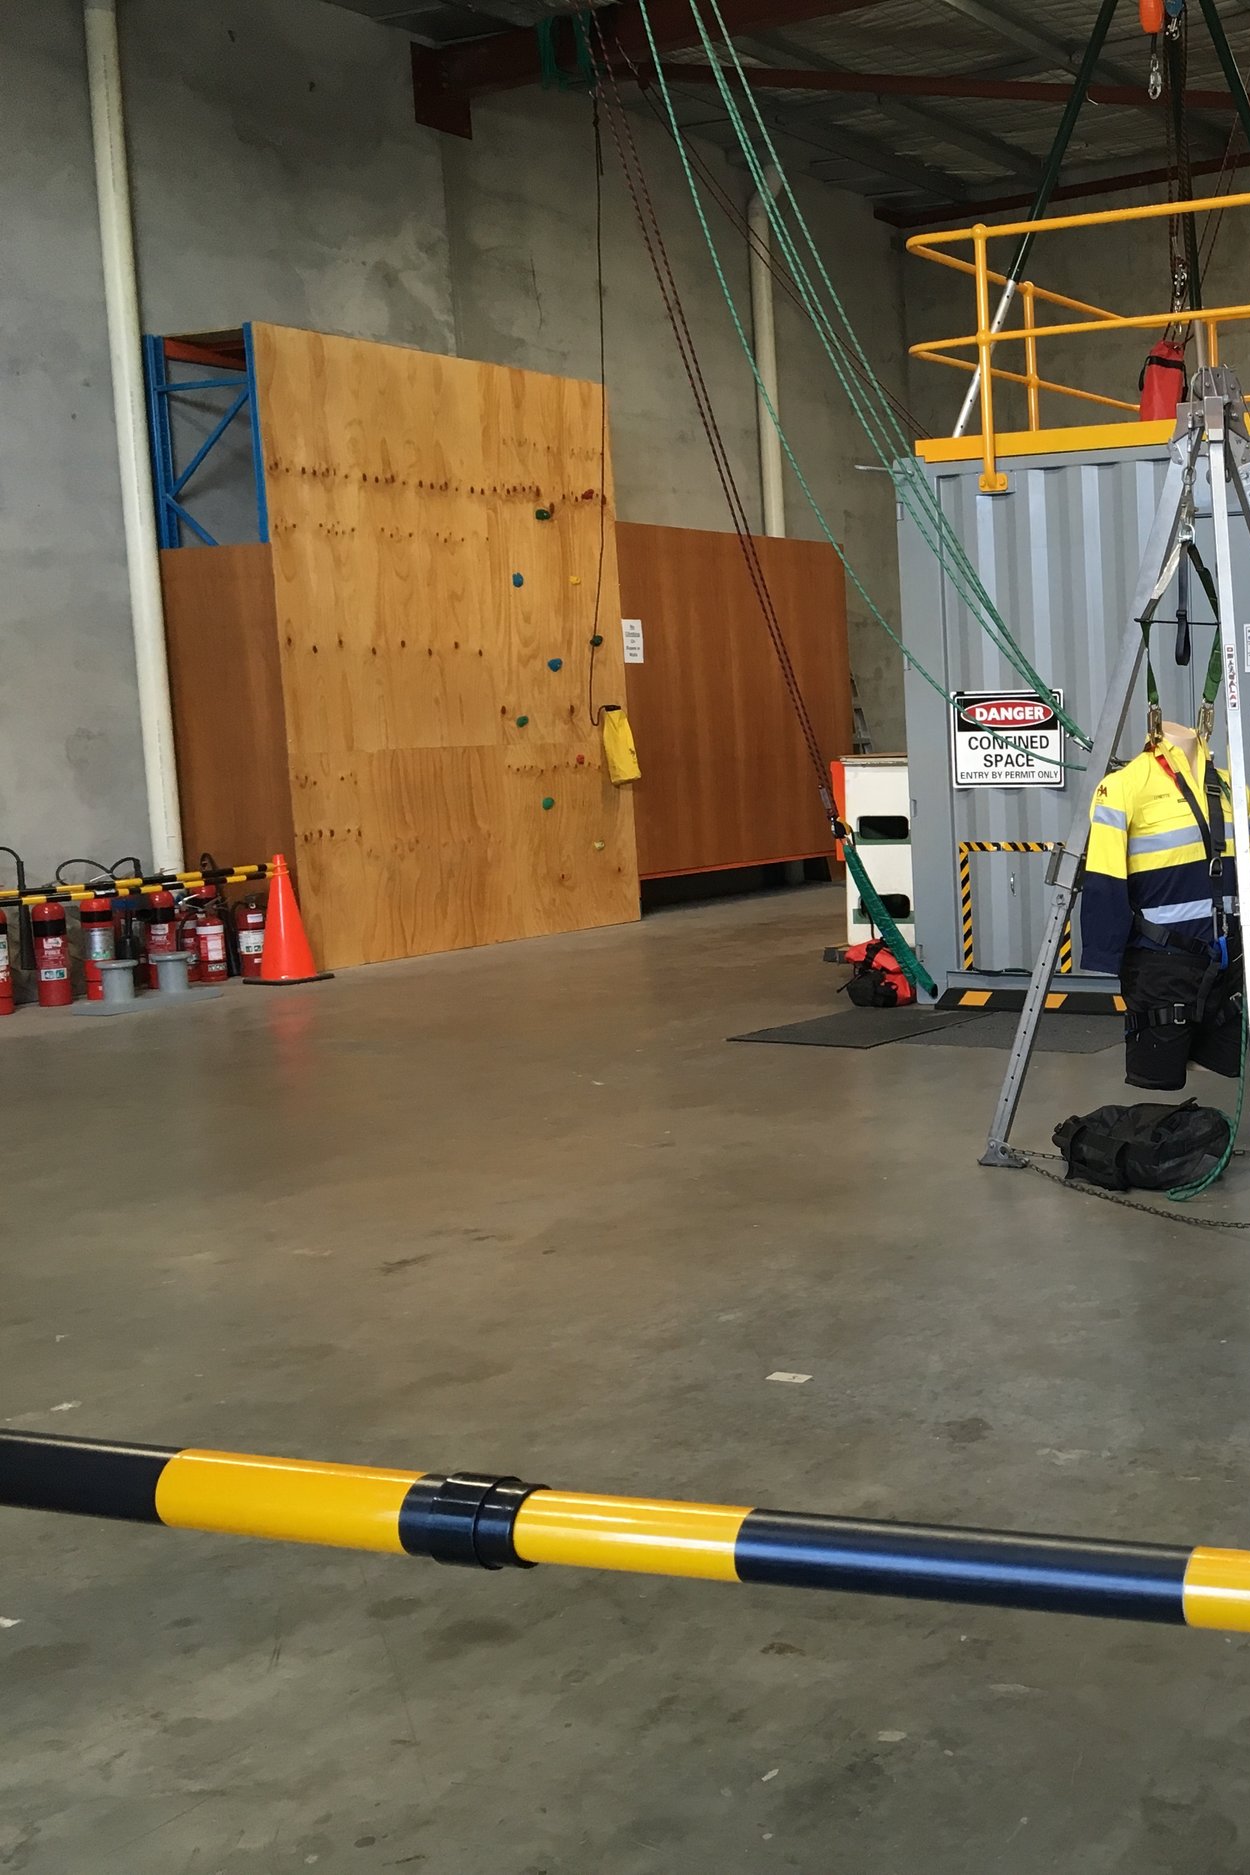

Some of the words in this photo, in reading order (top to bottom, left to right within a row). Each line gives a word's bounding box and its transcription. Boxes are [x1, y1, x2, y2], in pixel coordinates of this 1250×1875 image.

[975, 706, 1045, 721] DANGER
[968, 735, 1050, 750] CONFINED
[983, 754, 1035, 768] SPACE
[960, 771, 989, 779] ENTRY
[991, 771, 1003, 779] BY
[1005, 770, 1035, 779] PERMIT
[1037, 770, 1059, 779] ONLY
